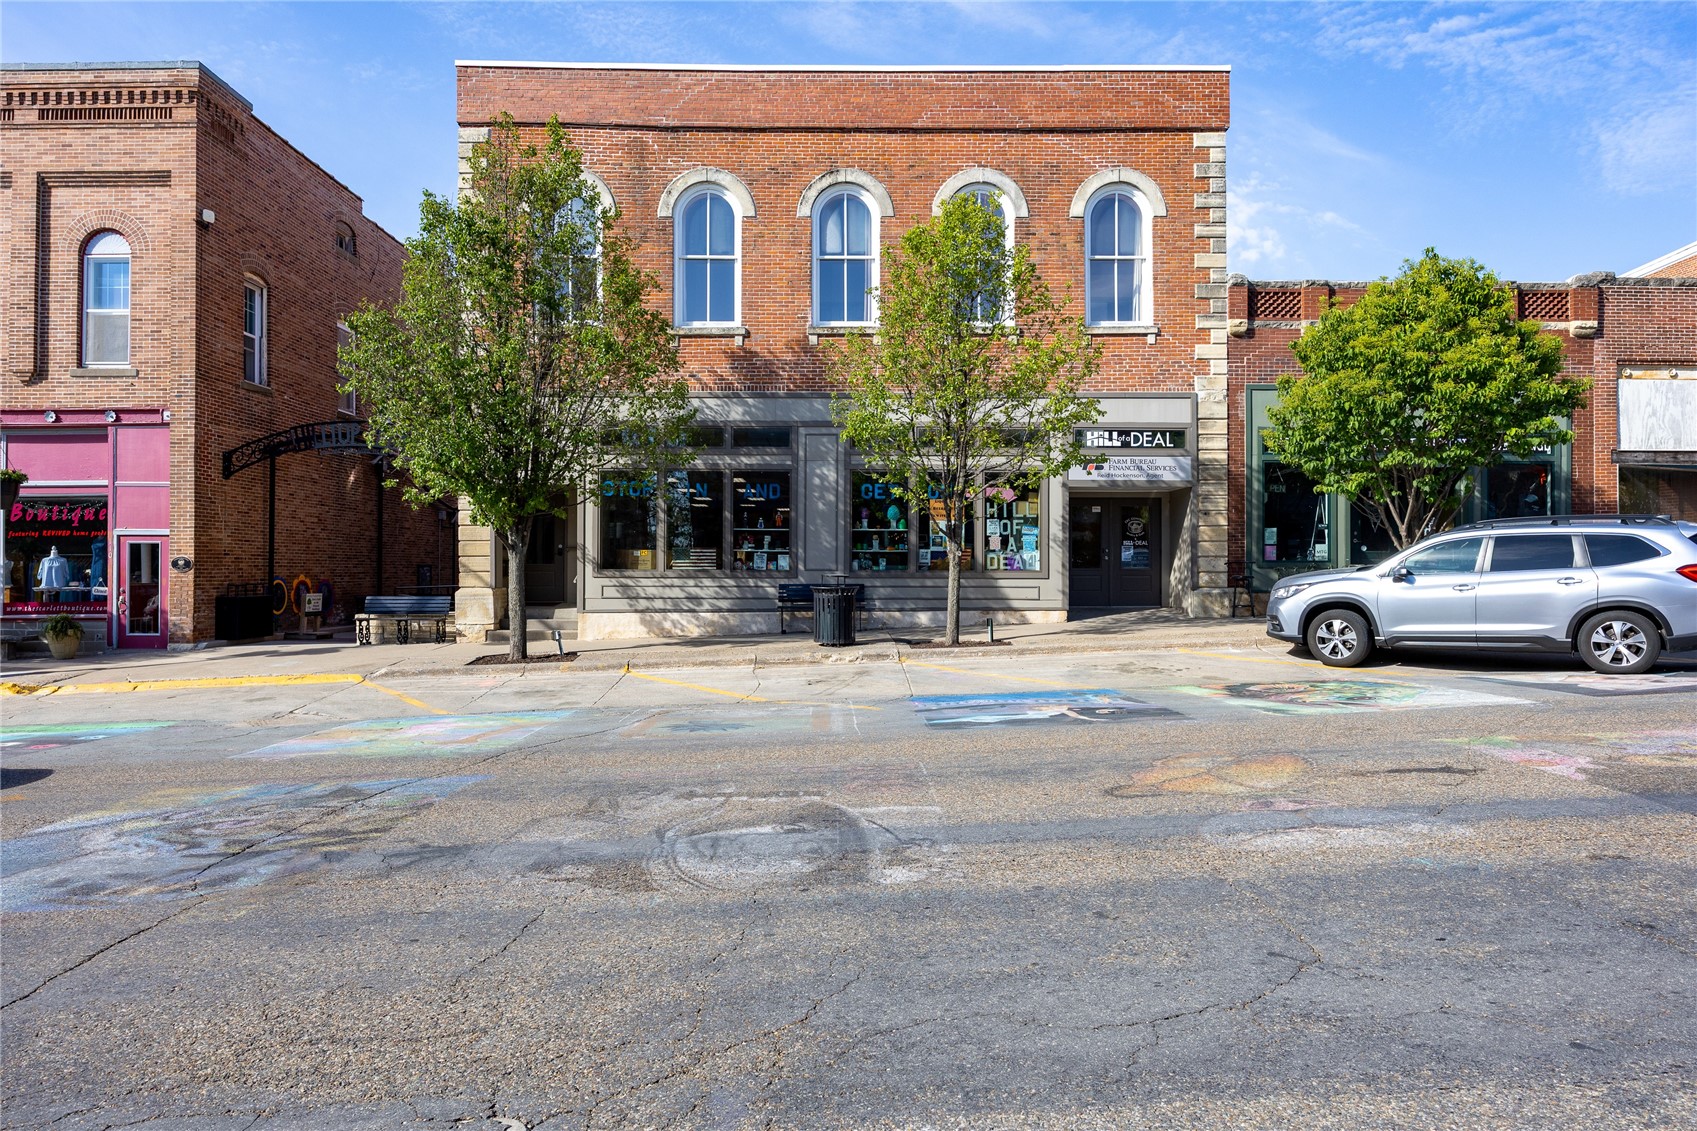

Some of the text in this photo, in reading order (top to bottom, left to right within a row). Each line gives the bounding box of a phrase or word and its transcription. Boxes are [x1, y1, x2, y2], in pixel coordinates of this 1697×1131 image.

[1130, 431, 1174, 447] DEAL
[1108, 464, 1177, 472] FINANCIAL SERVICES
[1146, 472, 1164, 480] Agent
[744, 482, 781, 500] AND
[10, 502, 107, 527] Boutique
[986, 501, 1037, 518] HILL
[7, 530, 39, 539] featuring
[42, 529, 71, 537] REVIVED
[1000, 519, 1024, 535] OF
[1006, 536, 1017, 552] A
[986, 553, 1037, 570] DEAL
